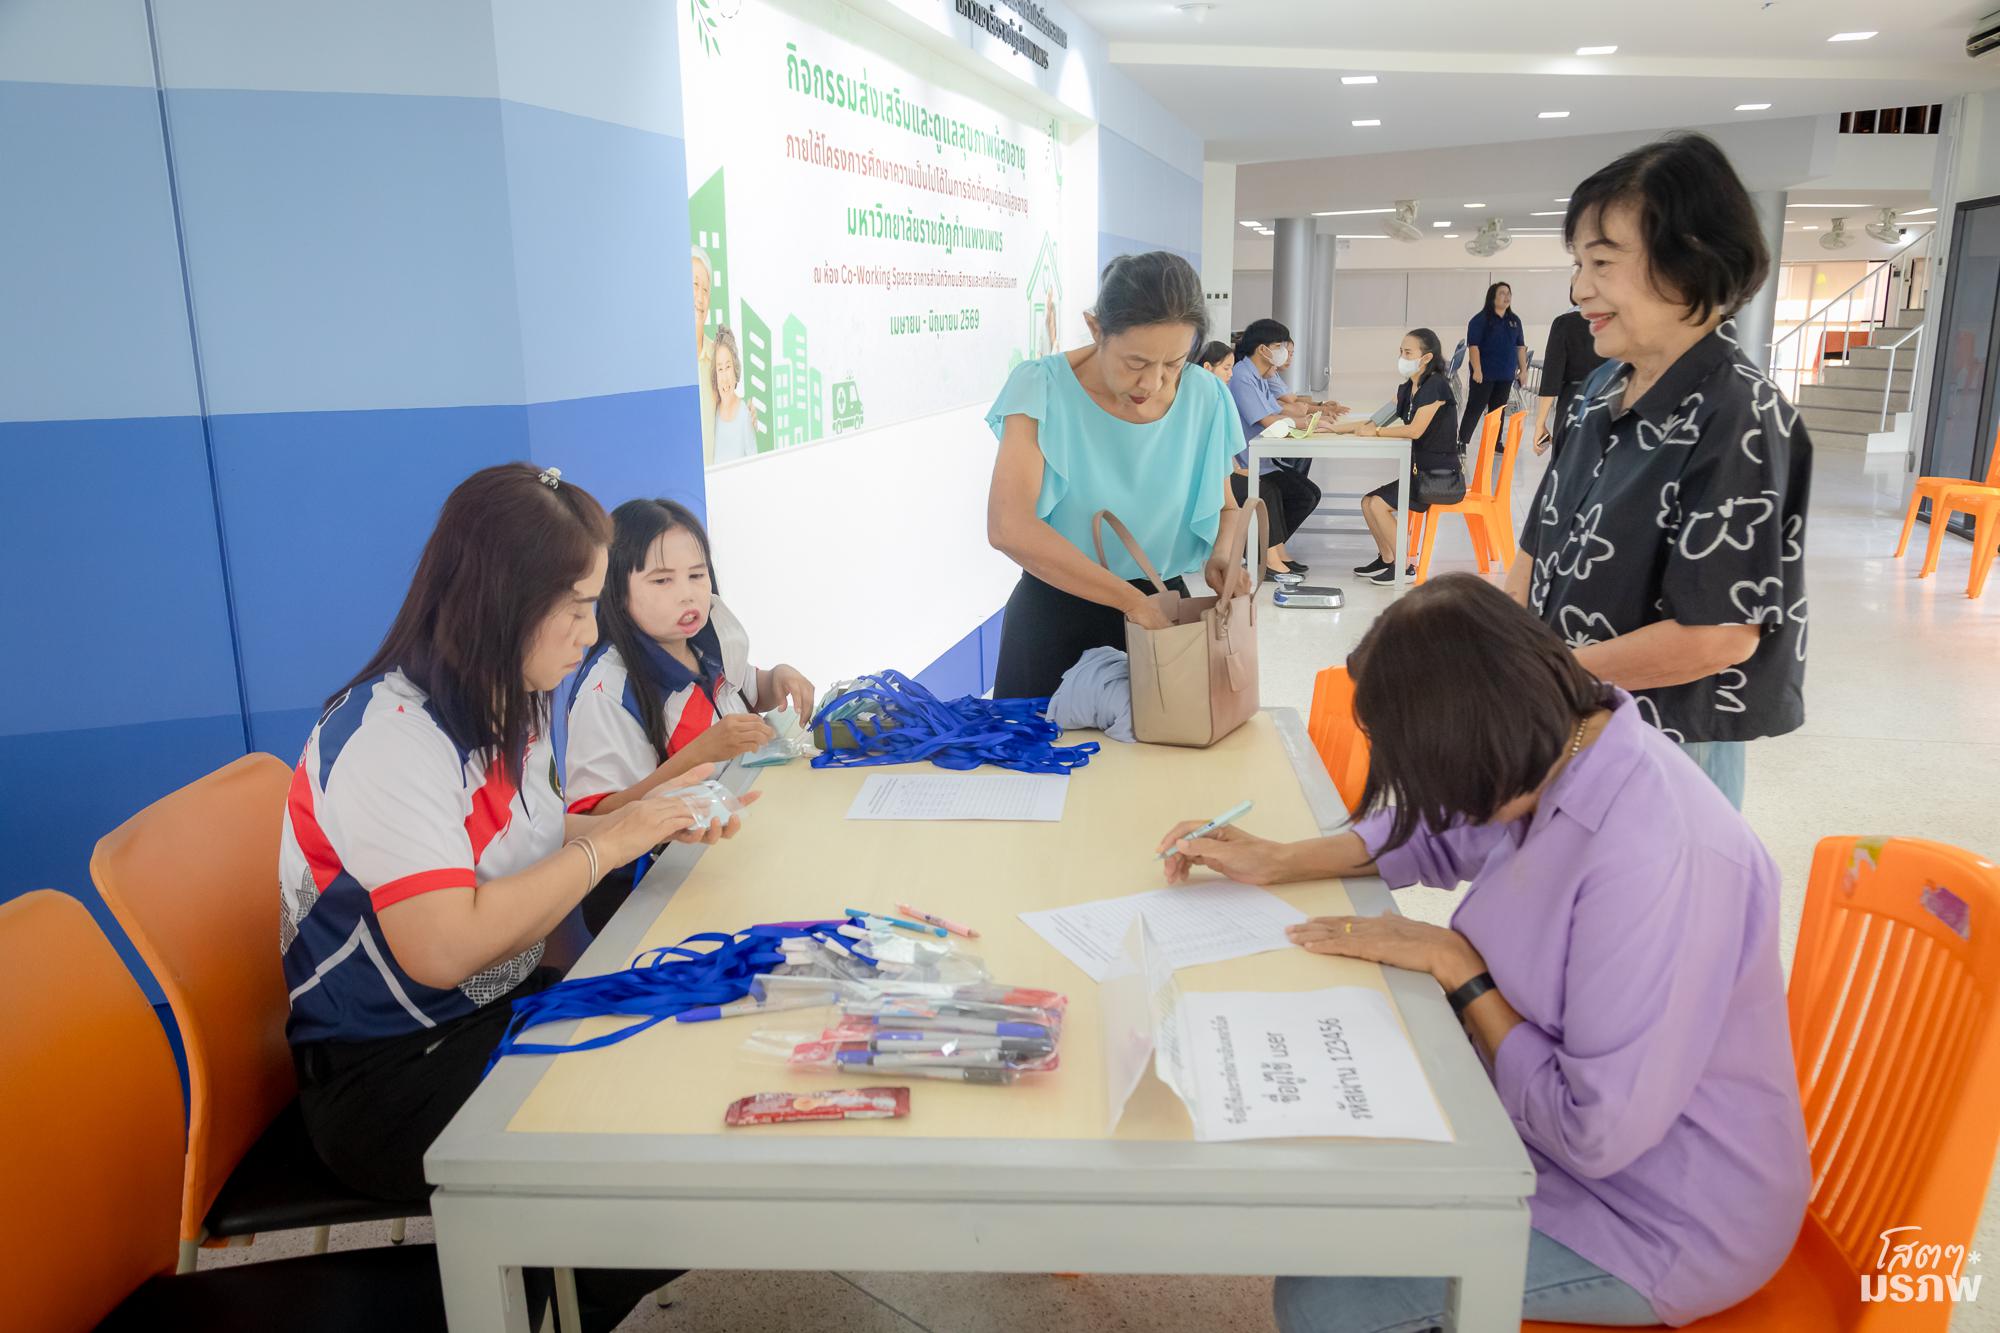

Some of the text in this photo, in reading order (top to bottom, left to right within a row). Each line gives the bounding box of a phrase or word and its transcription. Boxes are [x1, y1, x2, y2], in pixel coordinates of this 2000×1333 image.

[786, 42, 1026, 180] กิจกรรมส่งเสริมและดูแลสุขภาพผู้สูงอายุ
[847, 203, 1003, 255] มหาวิทยาลัยราชภัฏกำแพงเพชร
[824, 260, 839, 284] ห้อง
[841, 264, 891, 290] Co-Working
[892, 267, 912, 290] Space
[890, 315, 921, 335] เมษายน
[929, 310, 958, 339] มิถุนายน
[960, 309, 980, 330] 2569
[1261, 1032, 1306, 1104] ชื่อผู้ใช้ user
[1318, 1017, 1373, 1120] รหัสผ่าน 123456
